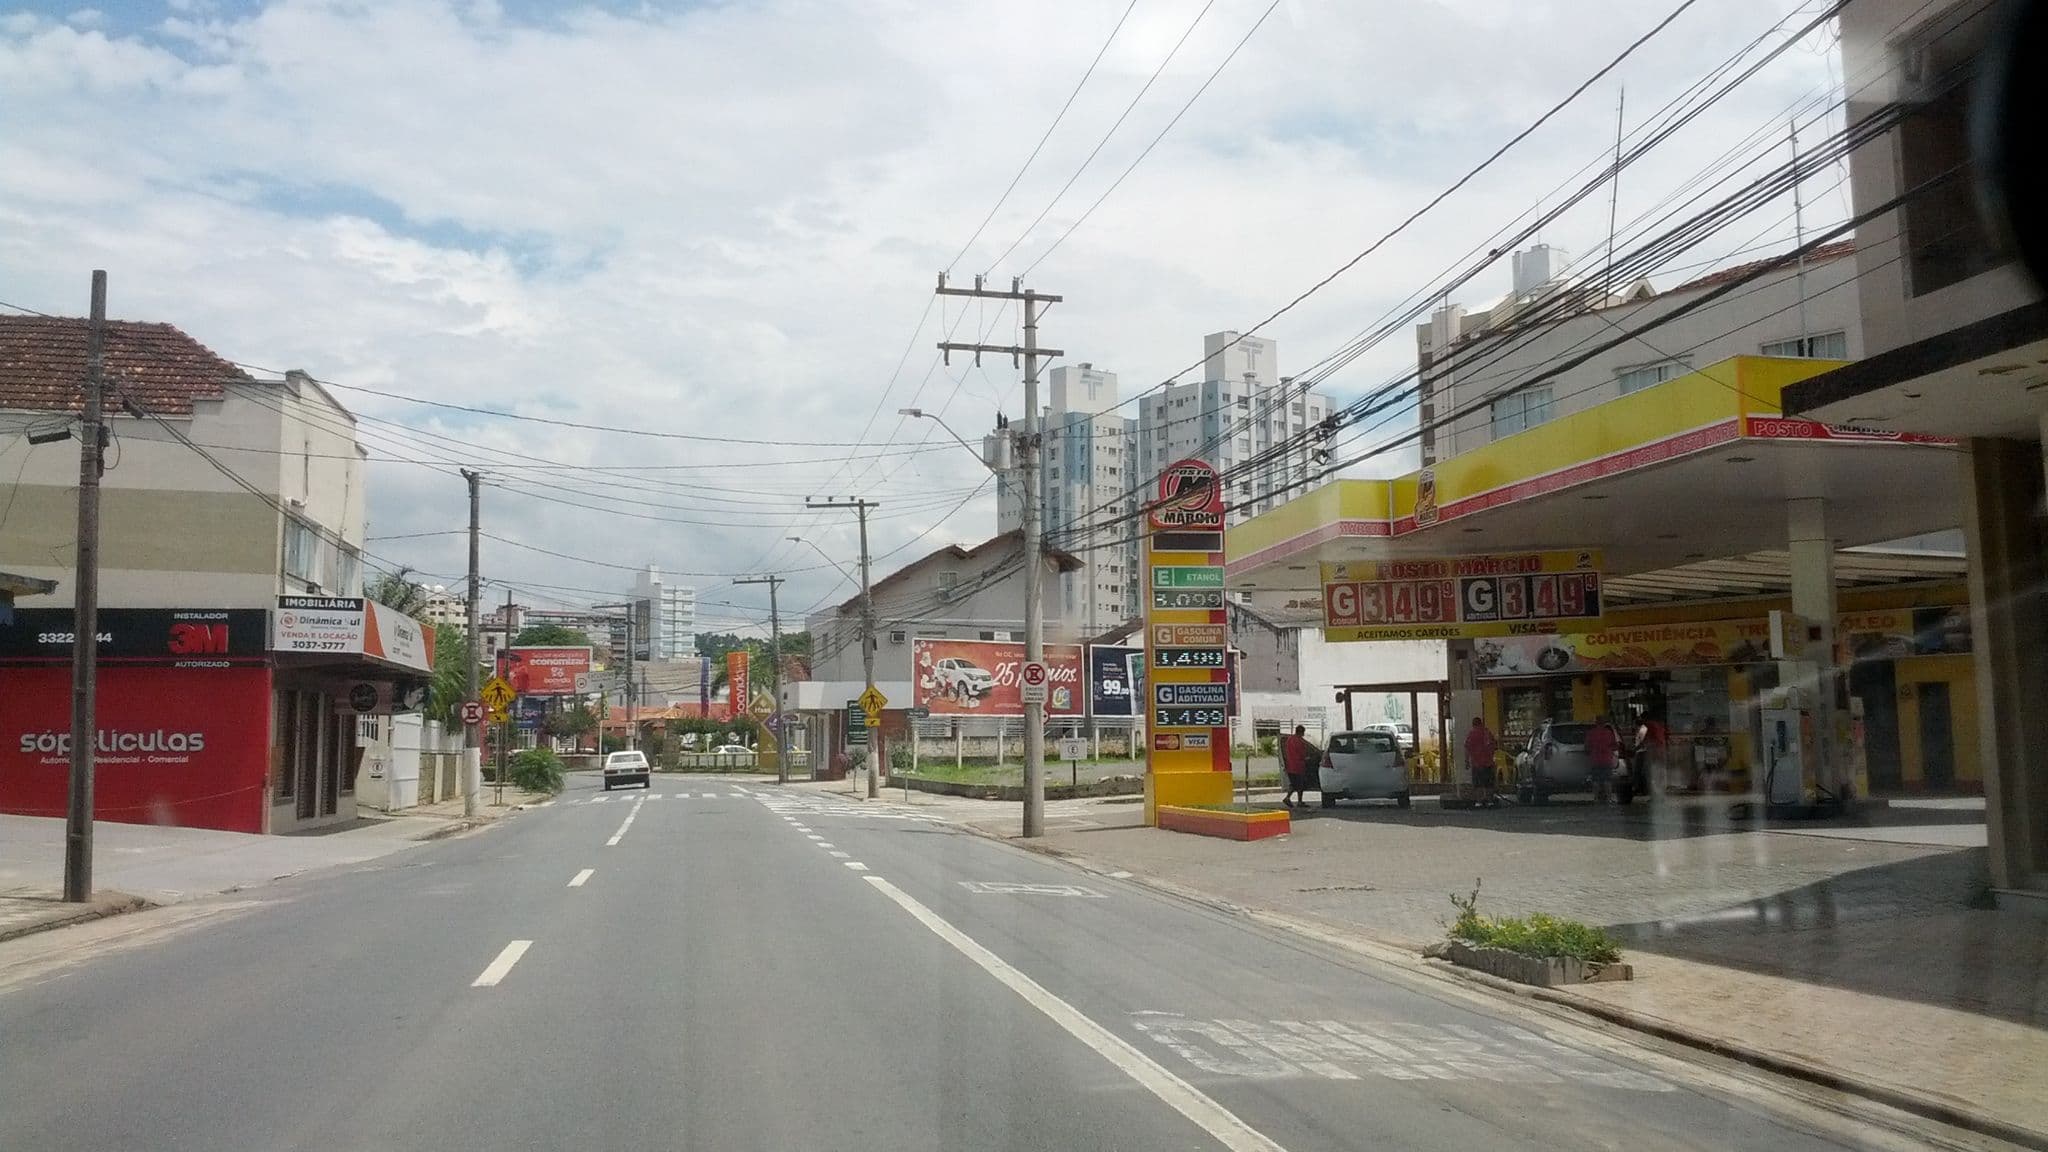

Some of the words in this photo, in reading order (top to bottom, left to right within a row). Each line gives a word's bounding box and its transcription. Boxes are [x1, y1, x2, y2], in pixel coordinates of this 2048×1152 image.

[1754, 421, 1812, 437] POSTO
[1157, 570, 1169, 585] E
[1187, 573, 1221, 581] ETANOL
[1376, 561, 1449, 580] POSTO
[285, 598, 357, 609] IMOBILIÁRIA
[1332, 585, 1356, 617] G
[1467, 580, 1492, 612] G
[299, 615, 342, 626] Dinâmica
[281, 631, 310, 639] VENDA
[318, 631, 358, 641] LOCAÇÃO
[1157, 628, 1171, 644] G
[1177, 627, 1222, 635] GASOLINA
[1357, 629, 1413, 639] ACEITAMOS
[1415, 627, 1460, 637] CARTÕES
[1508, 623, 1537, 634] VISA
[167, 623, 229, 654] 3M
[291, 641, 346, 650] 3037-3777
[1183, 636, 1217, 644] COMUM
[994, 662, 1018, 686] 25
[1158, 687, 1173, 702] G
[1178, 686, 1224, 694] GASOLINA
[1178, 694, 1225, 702] ADITIVADA
[20, 729, 205, 756] sóplículas
[147, 755, 189, 764] Comercial
